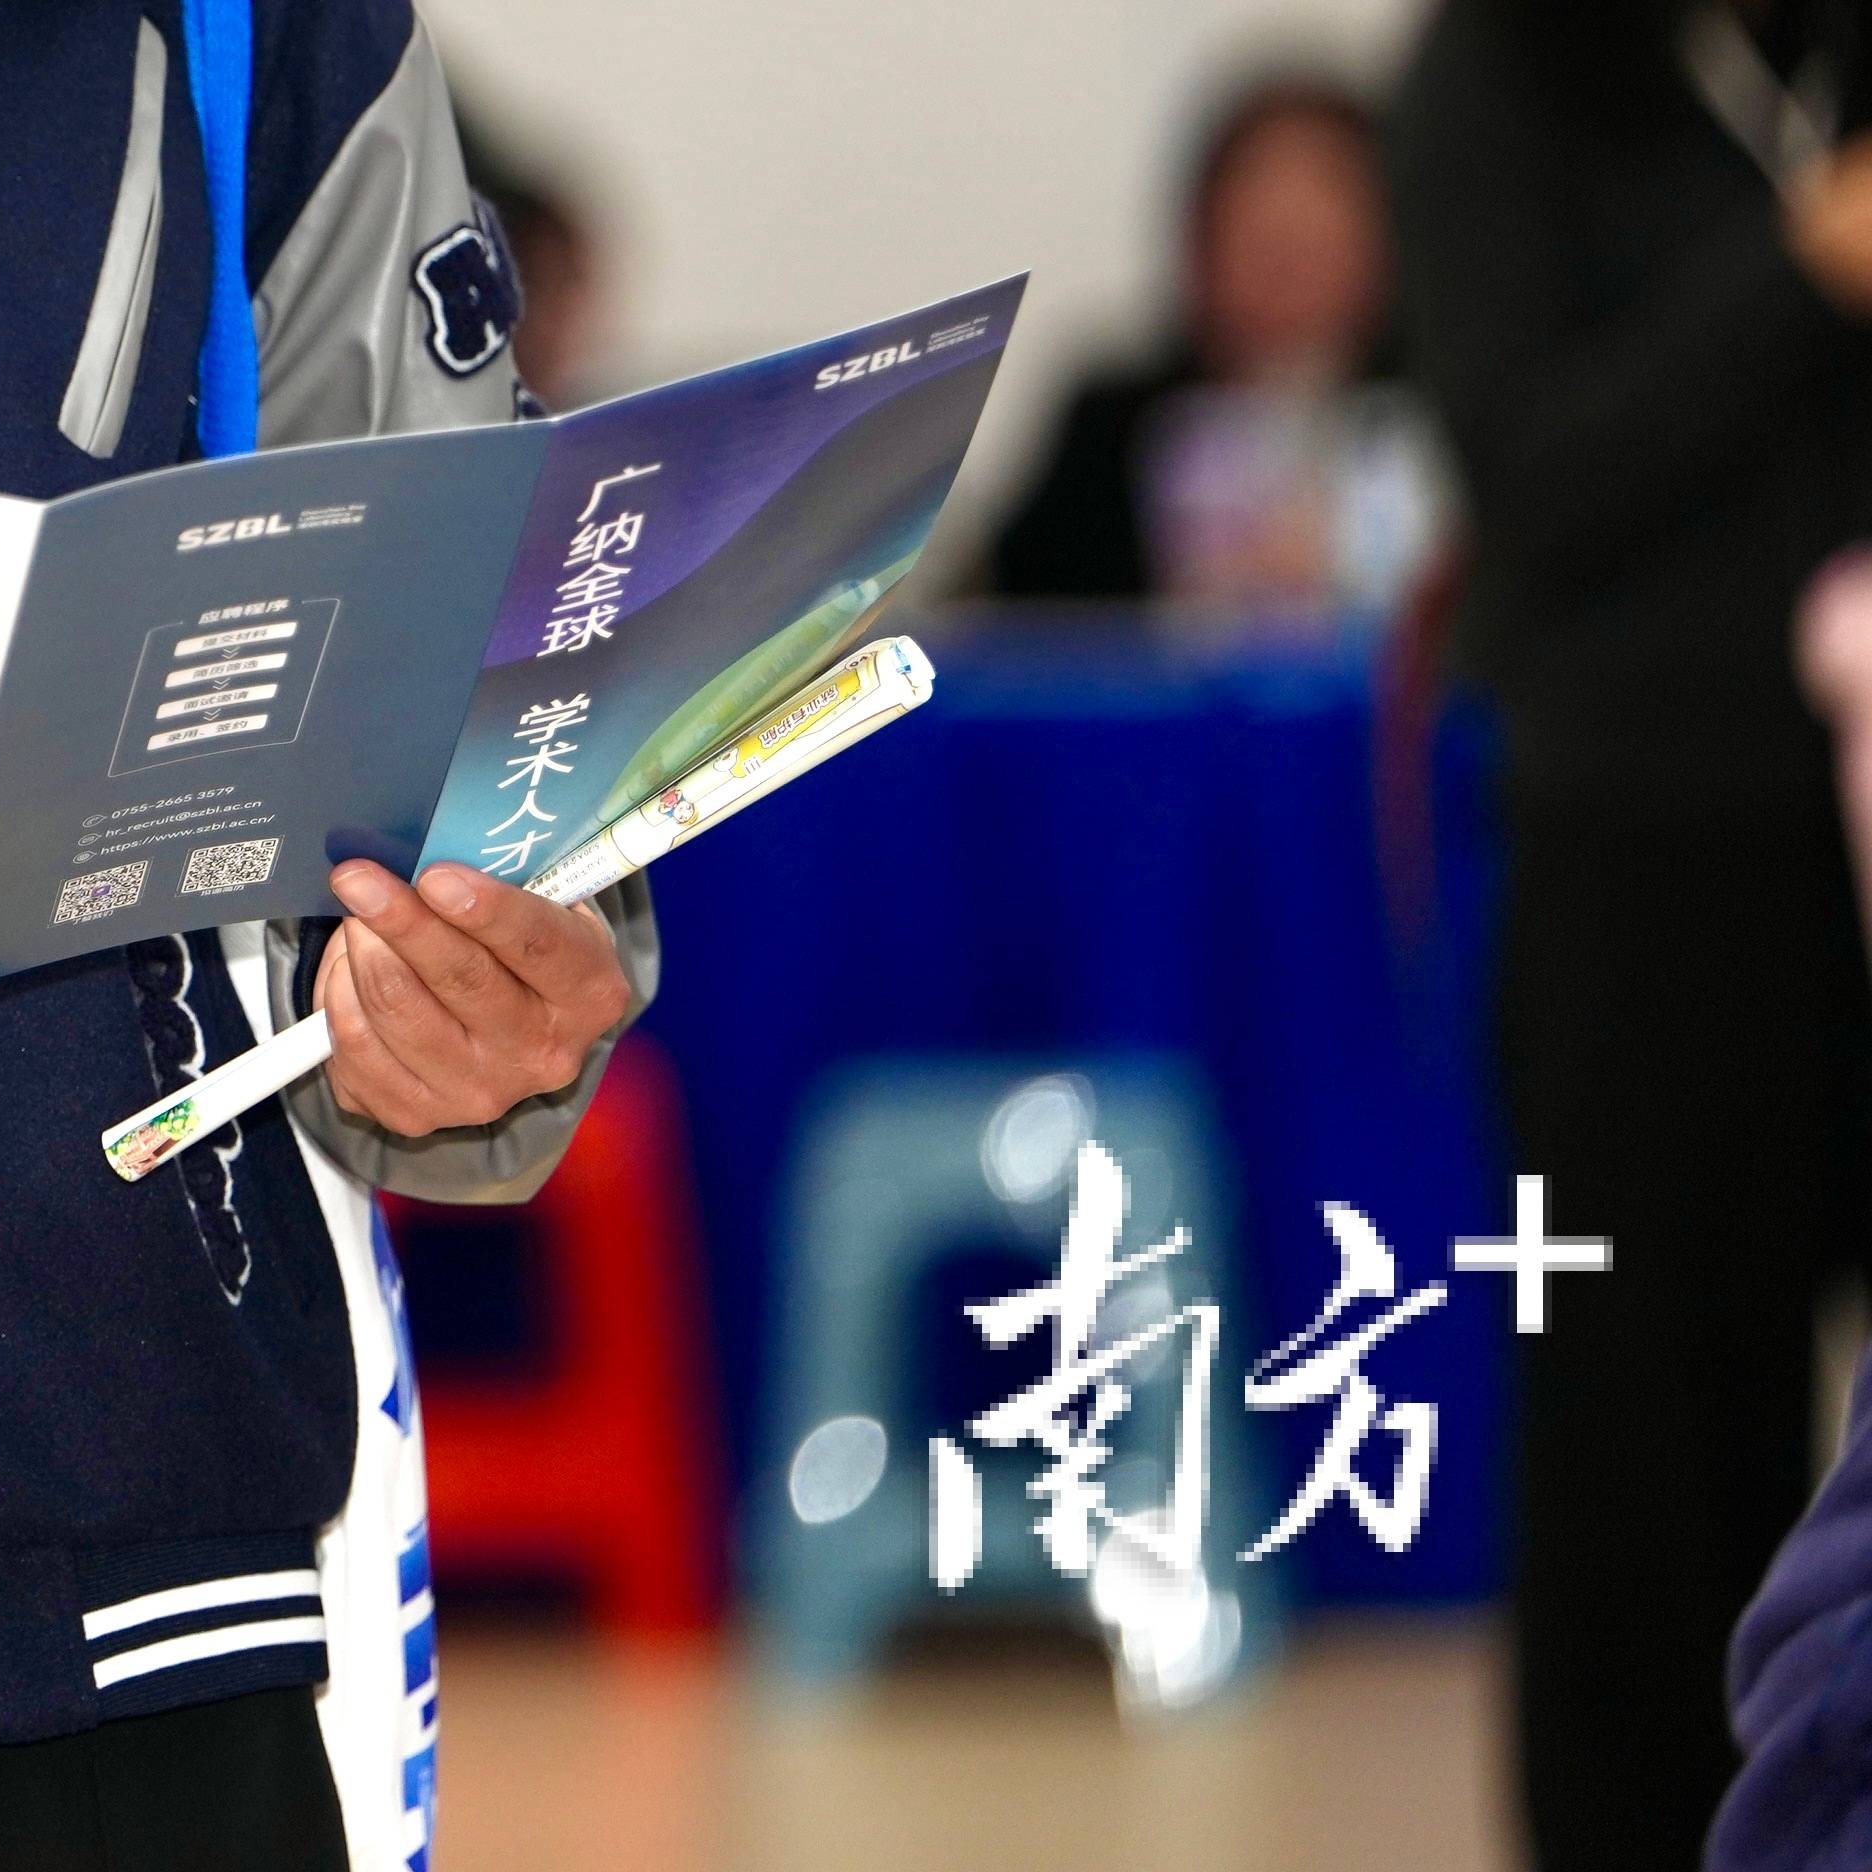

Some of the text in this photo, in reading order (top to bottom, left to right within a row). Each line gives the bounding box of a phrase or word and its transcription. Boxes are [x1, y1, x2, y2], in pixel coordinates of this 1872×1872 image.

[814, 341, 921, 390] SZBL
[176, 513, 293, 554] SZBL
[536, 462, 661, 658] 广纳全球
[199, 599, 290, 625] 应聘程序
[111, 786, 234, 820] 0755-2665 3579
[479, 691, 590, 877] 学术人才
[100, 814, 276, 856] https://www.szbl.ac.cn/
[105, 799, 262, 838] hr_recruit@szbl.ac.cn
